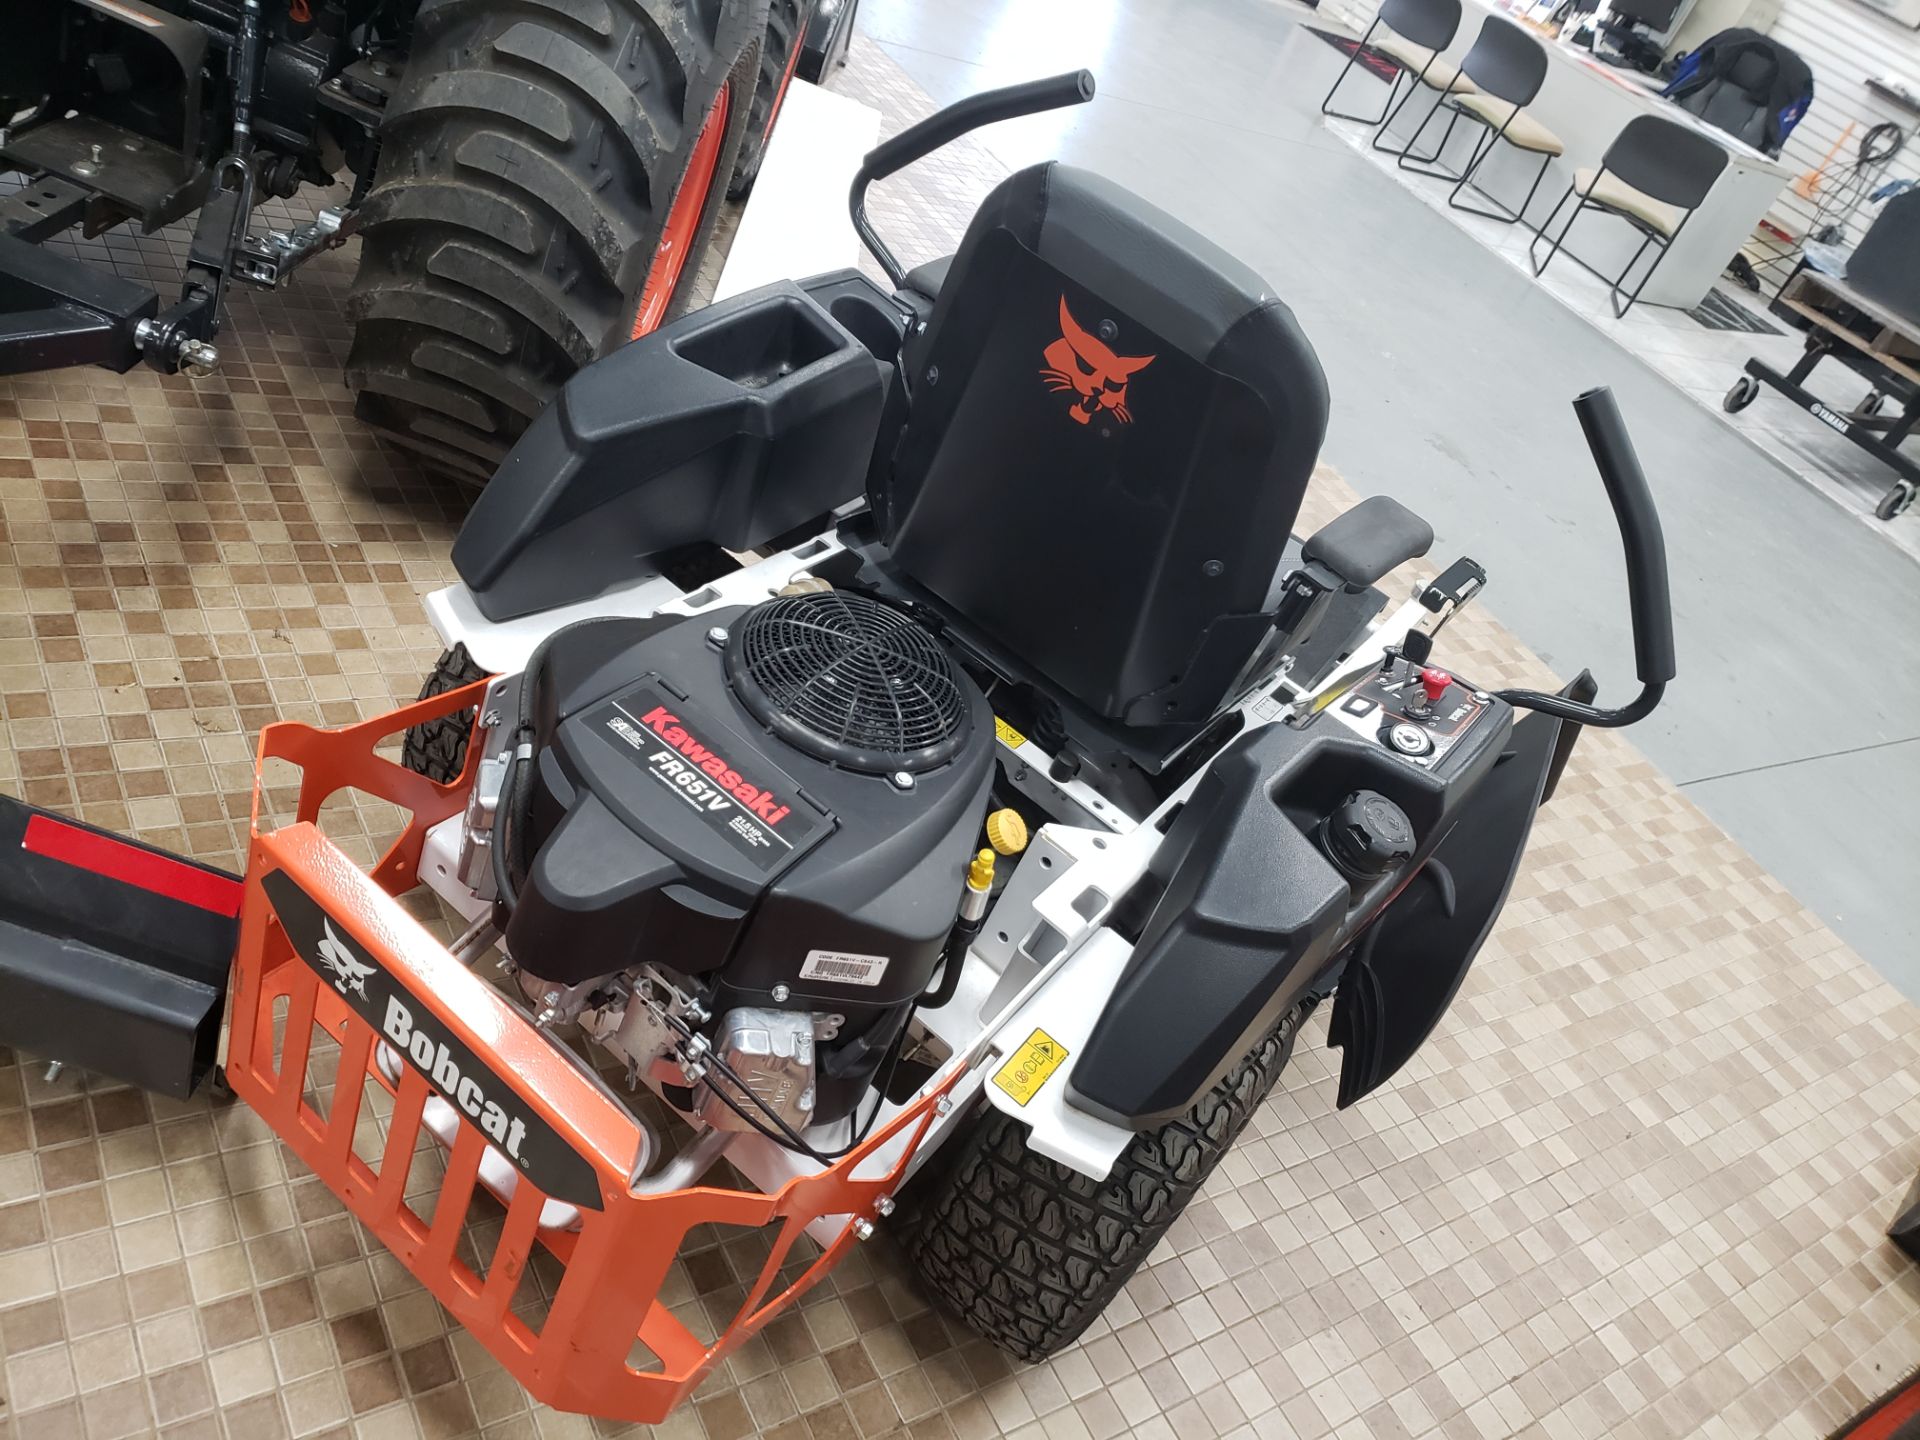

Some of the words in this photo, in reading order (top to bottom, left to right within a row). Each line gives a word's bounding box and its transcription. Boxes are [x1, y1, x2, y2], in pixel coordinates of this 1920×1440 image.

[1819, 408, 1849, 433] YAMAHA
[641, 706, 790, 825] Kawasaki
[648, 751, 731, 811] FR651V
[384, 994, 528, 1160] Bobcat
